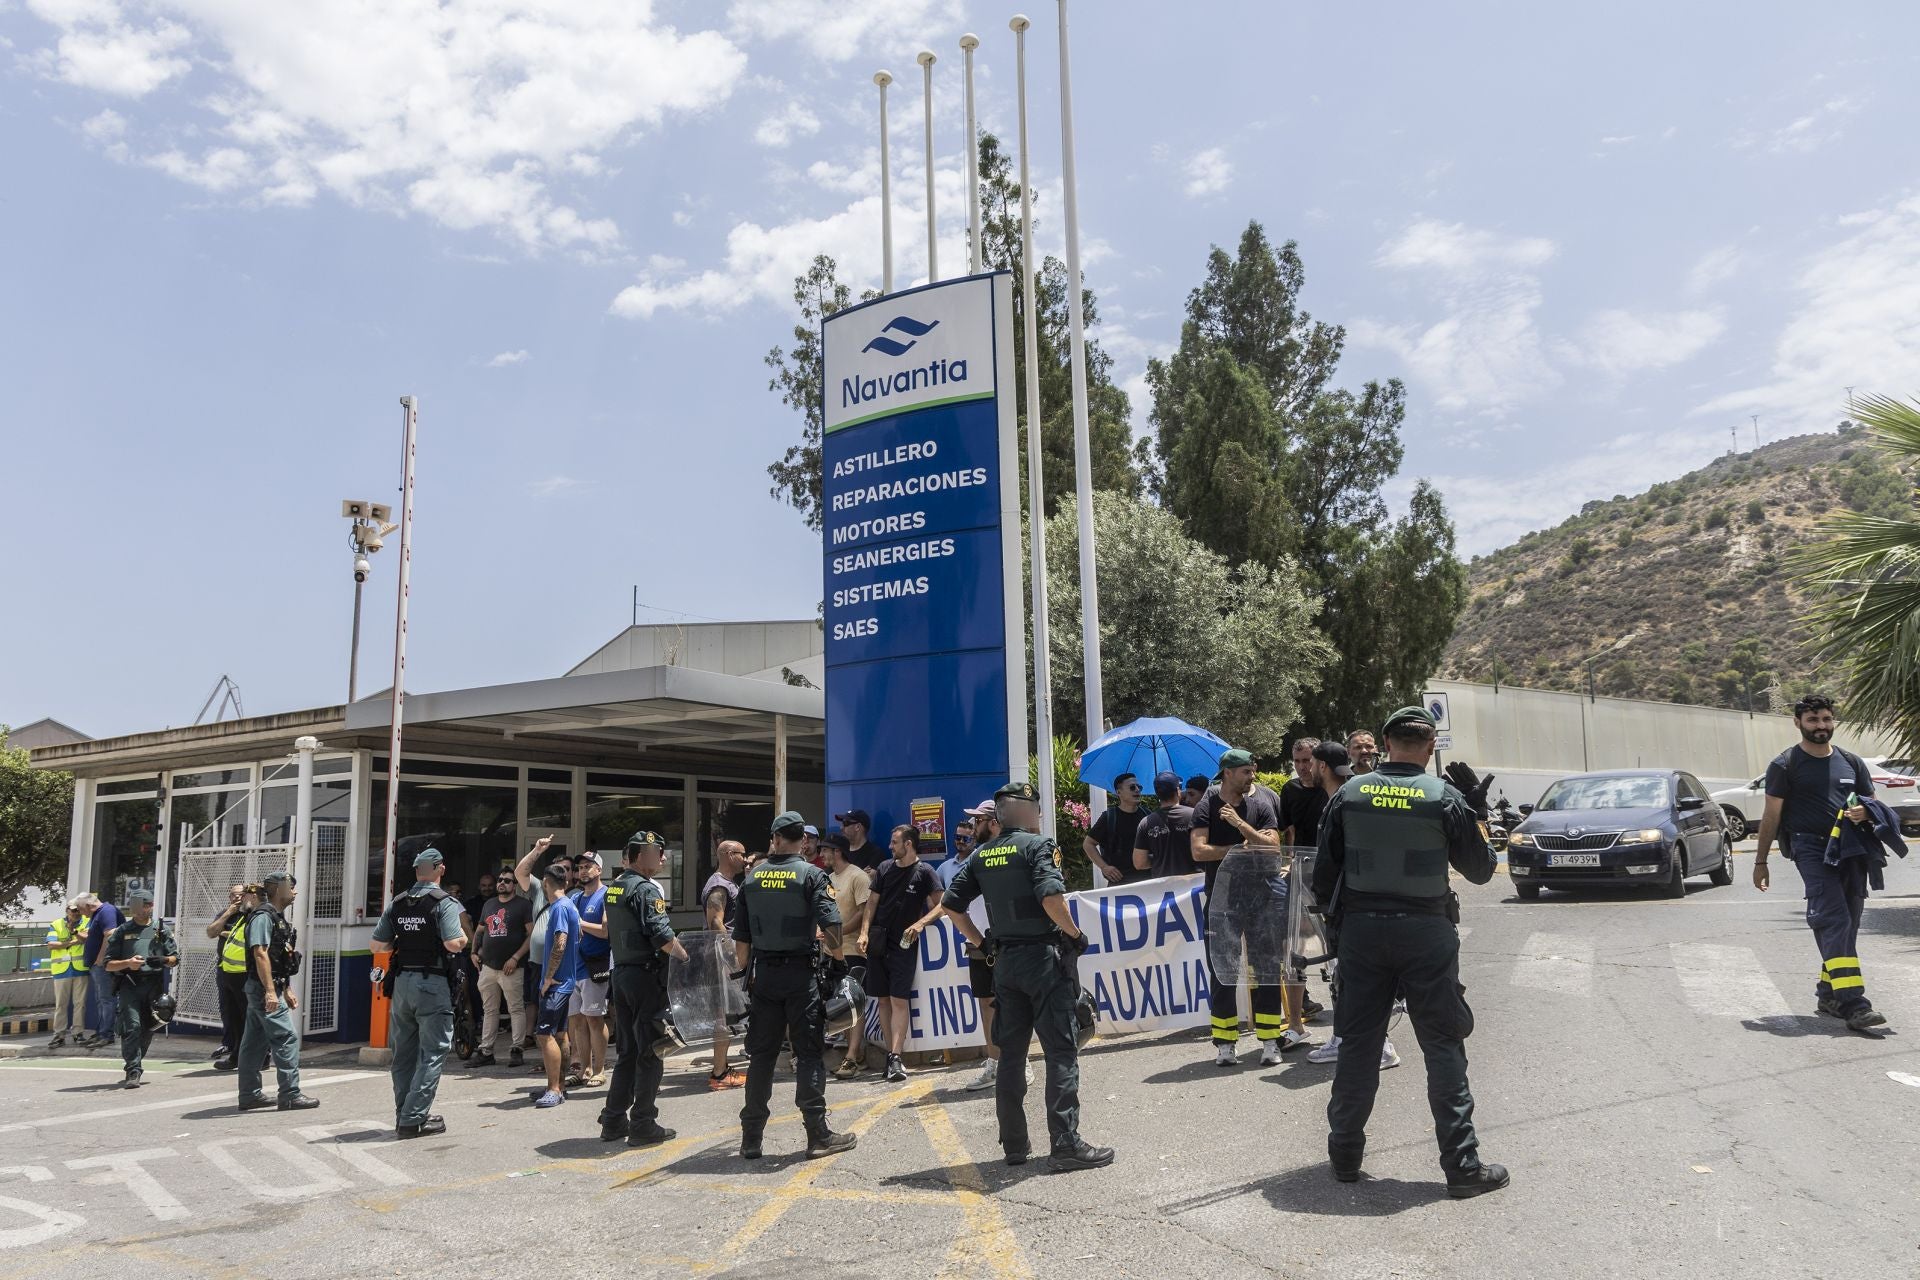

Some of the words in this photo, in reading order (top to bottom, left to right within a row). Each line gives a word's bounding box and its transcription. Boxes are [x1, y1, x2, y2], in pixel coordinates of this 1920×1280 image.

[842, 358, 968, 408] Navantia
[832, 440, 938, 479] ASTILLERO
[832, 467, 988, 511] REPARACIONES
[832, 511, 926, 545] MOTORES
[832, 538, 955, 575] SEANERGIES
[833, 576, 930, 608] SISTEMAS
[833, 617, 879, 641] SAES
[1359, 784, 1425, 798] GUARDIA
[1372, 796, 1411, 809] CIVIL
[980, 845, 1017, 857] GUARDIA
[985, 856, 1008, 867] CIVIL
[1553, 855, 1564, 864] ST
[754, 871, 797, 879] GUARDIA
[761, 880, 787, 888] CIVIL
[1068, 884, 1205, 955] LIDA
[1094, 958, 1213, 1021] AUXILIA
